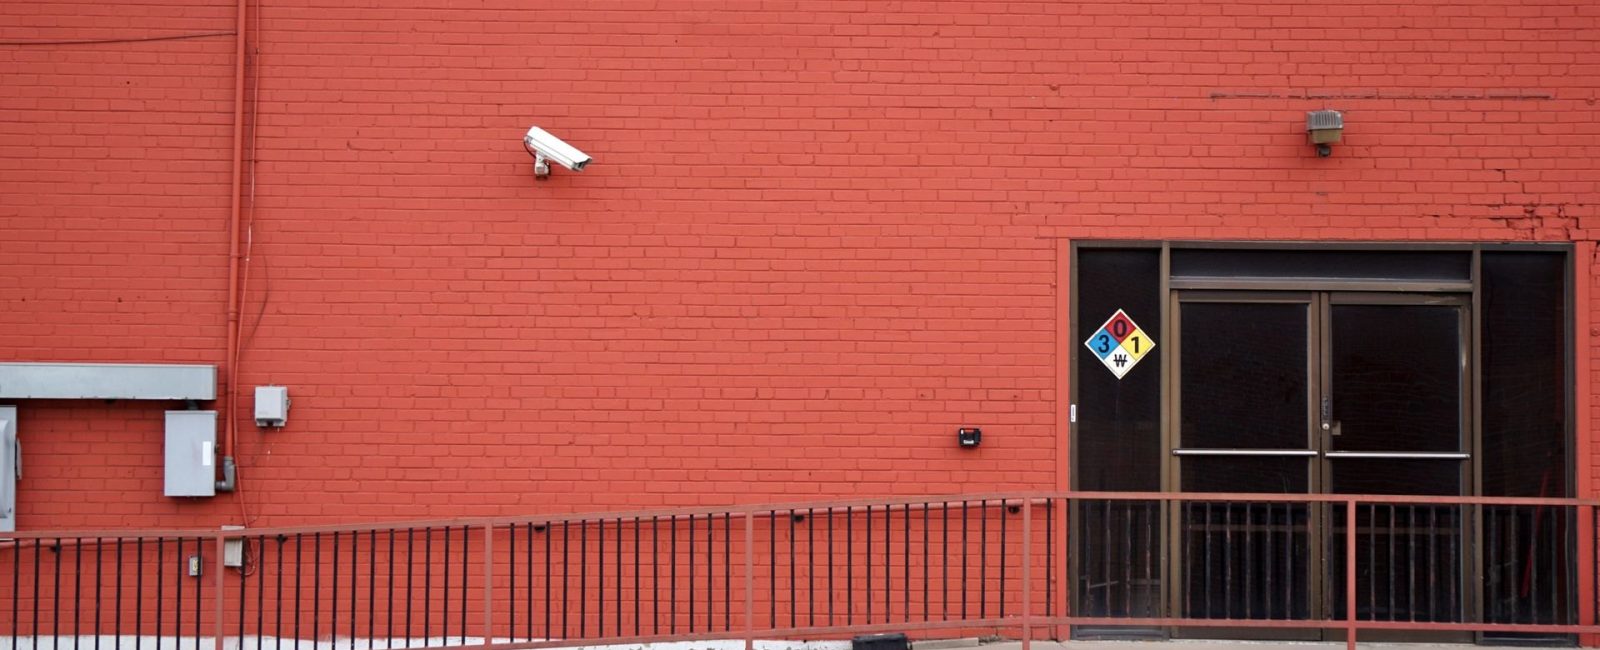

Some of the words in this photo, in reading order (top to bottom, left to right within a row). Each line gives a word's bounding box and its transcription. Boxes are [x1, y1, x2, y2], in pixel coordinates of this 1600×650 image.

[1113, 320, 1127, 337] 0
[1098, 334, 1110, 353] 3
[1131, 336, 1139, 353] 1
